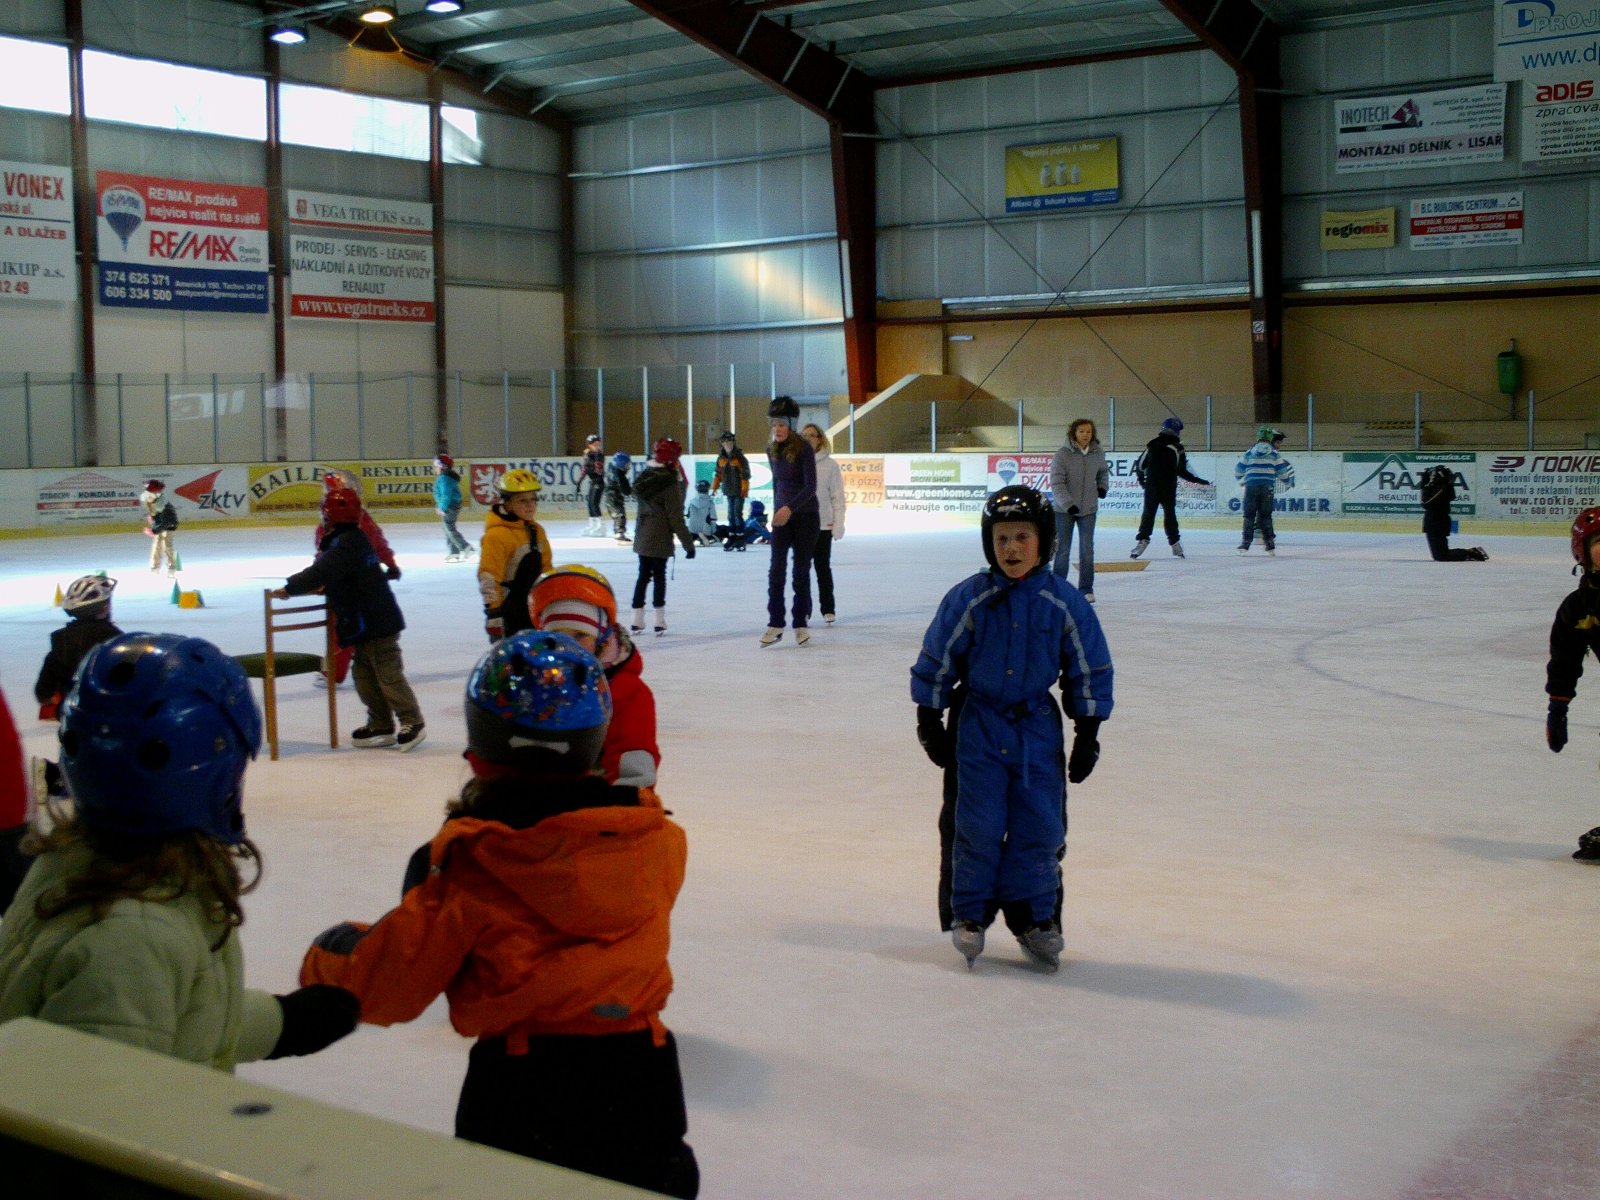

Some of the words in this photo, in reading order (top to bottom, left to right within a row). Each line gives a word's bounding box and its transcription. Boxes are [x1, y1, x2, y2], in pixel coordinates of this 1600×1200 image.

[1522, 42, 1600, 69] www.d
[1340, 105, 1389, 125] INOTECH
[1535, 103, 1600, 119] zpracova
[3, 171, 64, 200] VONEX
[148, 187, 193, 203] RE/MAX
[220, 213, 233, 223] na
[311, 203, 347, 219] VEGA
[349, 206, 398, 225] TRUCKS
[4, 225, 14, 236] A
[1325, 221, 1390, 239] regiomix
[149, 230, 239, 263] RE/MAX
[296, 239, 336, 256] PRODEJ
[344, 244, 378, 258] SERVIS
[387, 247, 427, 262] LEASING
[292, 258, 346, 275] NÁKLADNÍ
[347, 264, 355, 275] A
[406, 266, 431, 280] VOZY
[105, 271, 126, 283] 374
[129, 273, 150, 285] 625
[152, 274, 171, 286] 371
[104, 286, 126, 299] 606
[129, 287, 150, 300] 334
[153, 289, 172, 301] 500
[342, 280, 386, 294] RENAULT
[298, 300, 426, 319] www.vegatrucks.cz
[251, 467, 325, 500] BAILE
[1494, 473, 1531, 485] sportovní
[1533, 473, 1555, 485] dresy
[1556, 475, 1563, 483] a
[861, 491, 883, 504] 207
[886, 486, 986, 499] www.greenhome.cz
[1490, 485, 1527, 496] sportovní
[1529, 487, 1535, 495] a
[1537, 485, 1572, 495] reklamní
[199, 489, 246, 510] zktv
[892, 502, 940, 513] Nakupujte
[1499, 496, 1596, 506] www.rookie.cz
[1549, 507, 1564, 515] 021
